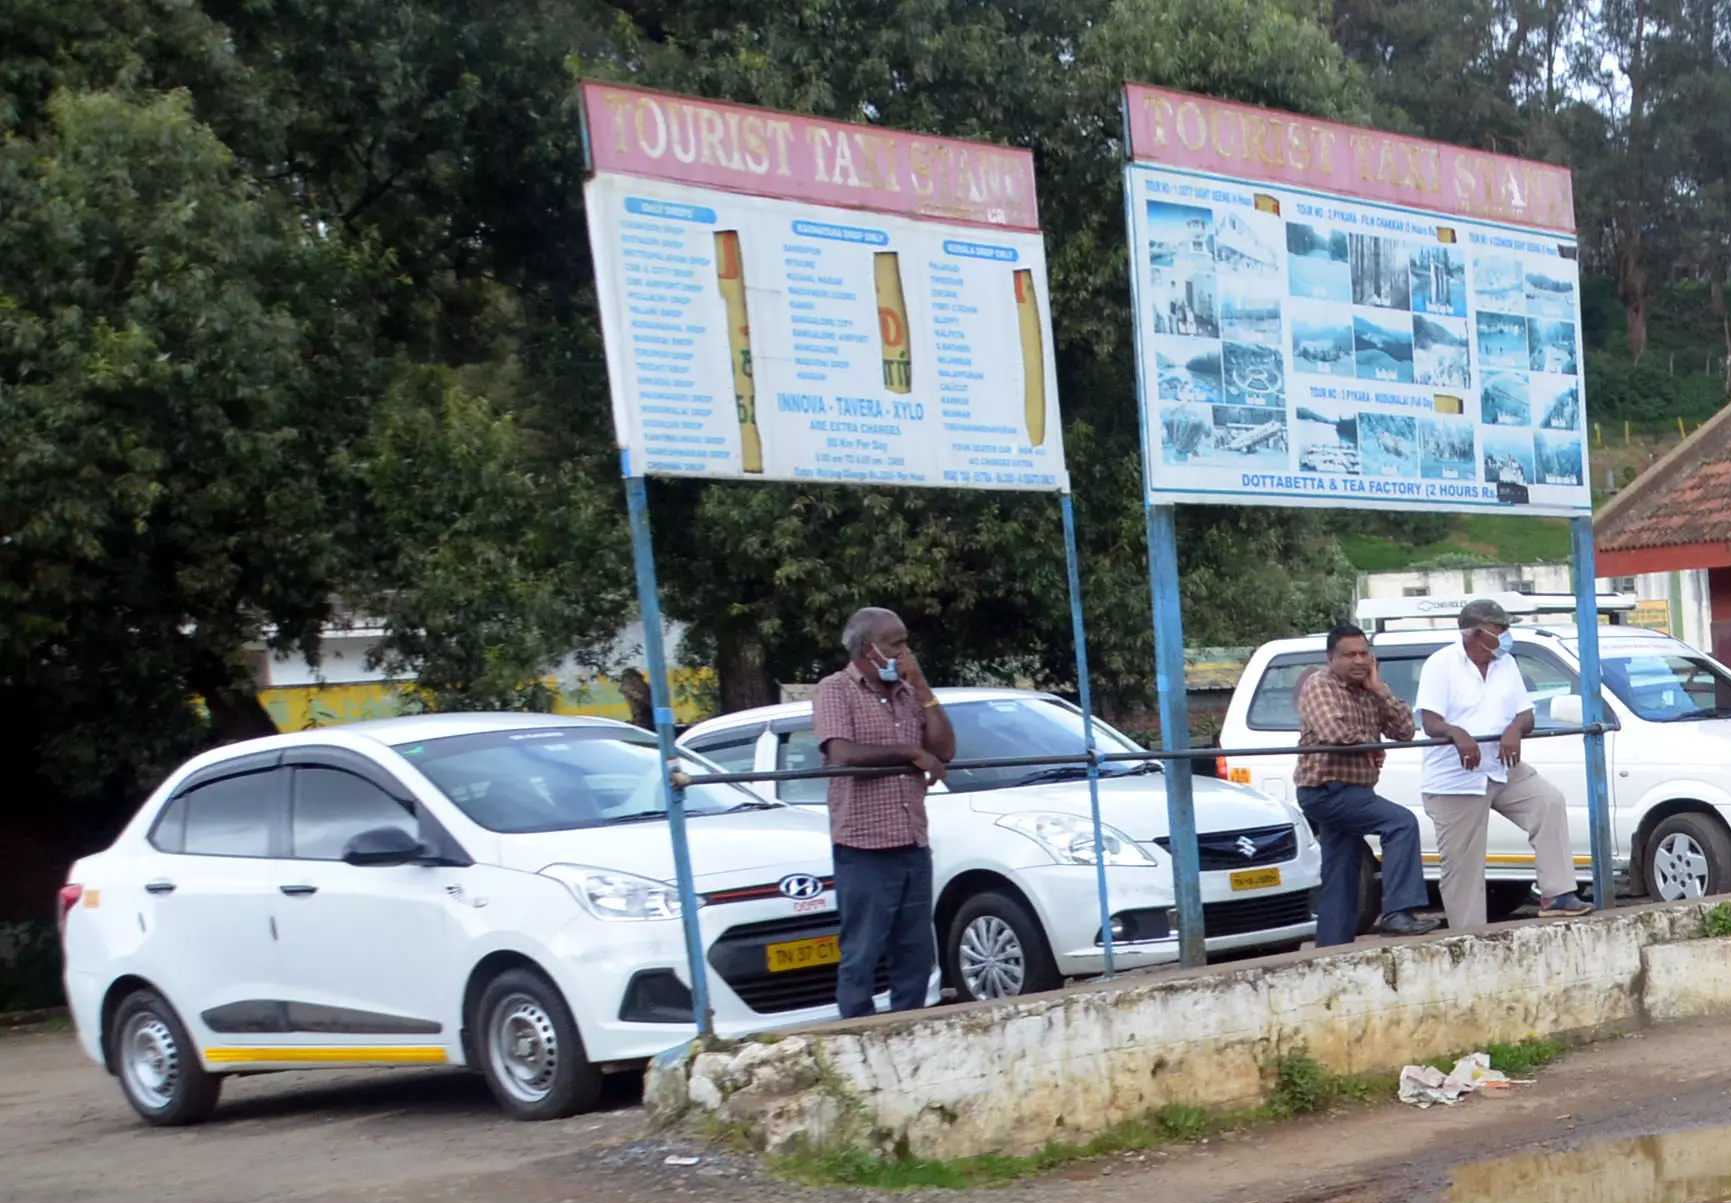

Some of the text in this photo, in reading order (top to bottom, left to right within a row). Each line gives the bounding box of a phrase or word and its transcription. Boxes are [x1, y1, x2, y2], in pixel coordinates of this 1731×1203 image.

[604, 95, 1025, 203] TOURIST TAXI STAND
[1144, 97, 1568, 213] TOURIST TAXI STAND
[777, 392, 827, 414] INNOVA
[836, 396, 883, 418] TAVERA
[893, 400, 925, 420] XYLO
[1242, 473, 1325, 490] DOTTABETTA
[1329, 478, 1338, 491] &
[1342, 479, 1365, 492] TEA
[1369, 480, 1422, 495] FACTORY
[1440, 483, 1479, 498] HOURS
